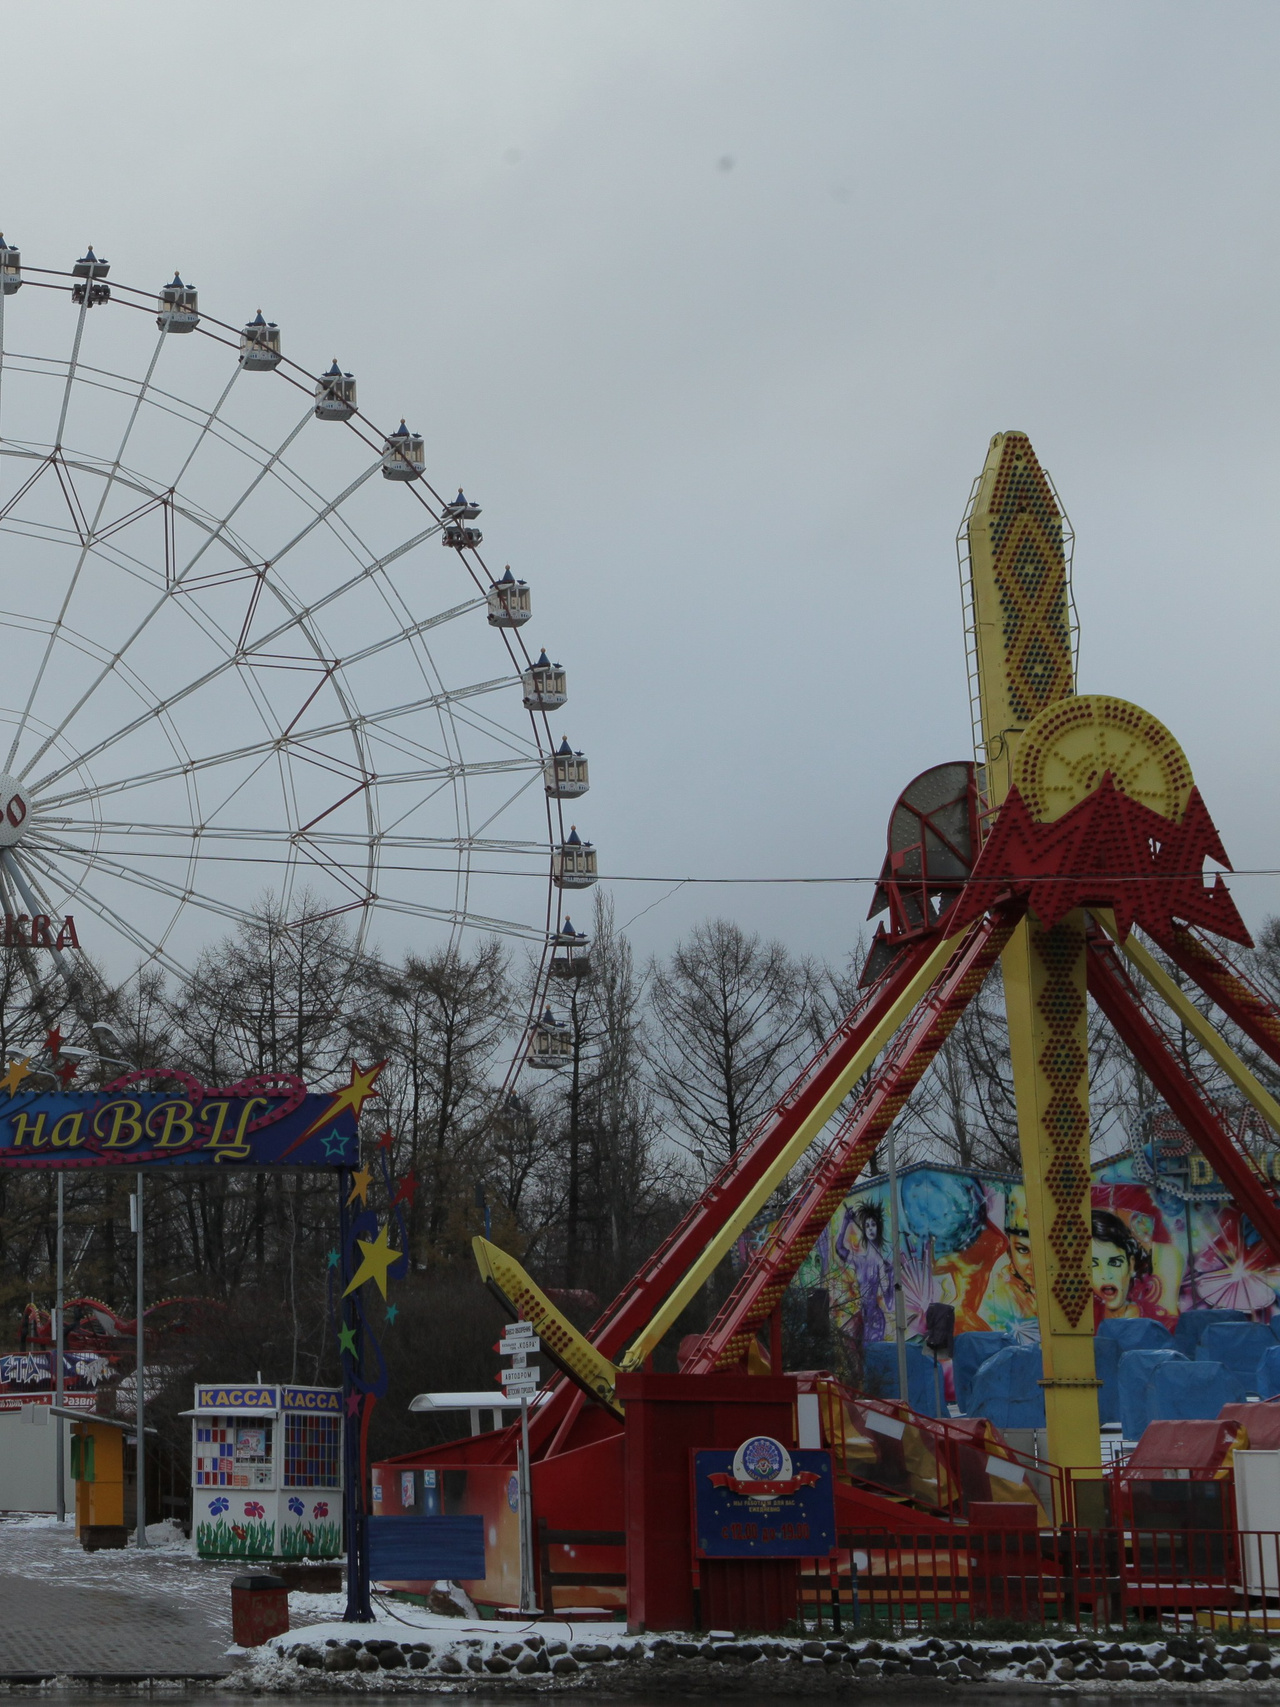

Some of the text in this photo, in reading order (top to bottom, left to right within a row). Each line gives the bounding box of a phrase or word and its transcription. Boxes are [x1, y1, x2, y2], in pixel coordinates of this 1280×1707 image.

[505, 1371, 532, 1380] АВТОДРОМ
[201, 1390, 273, 1405] КАССА
[283, 1392, 339, 1409] КАССА
[731, 1522, 758, 1540] 12.00
[762, 1526, 776, 1542] до
[781, 1522, 810, 1540] 19.00
